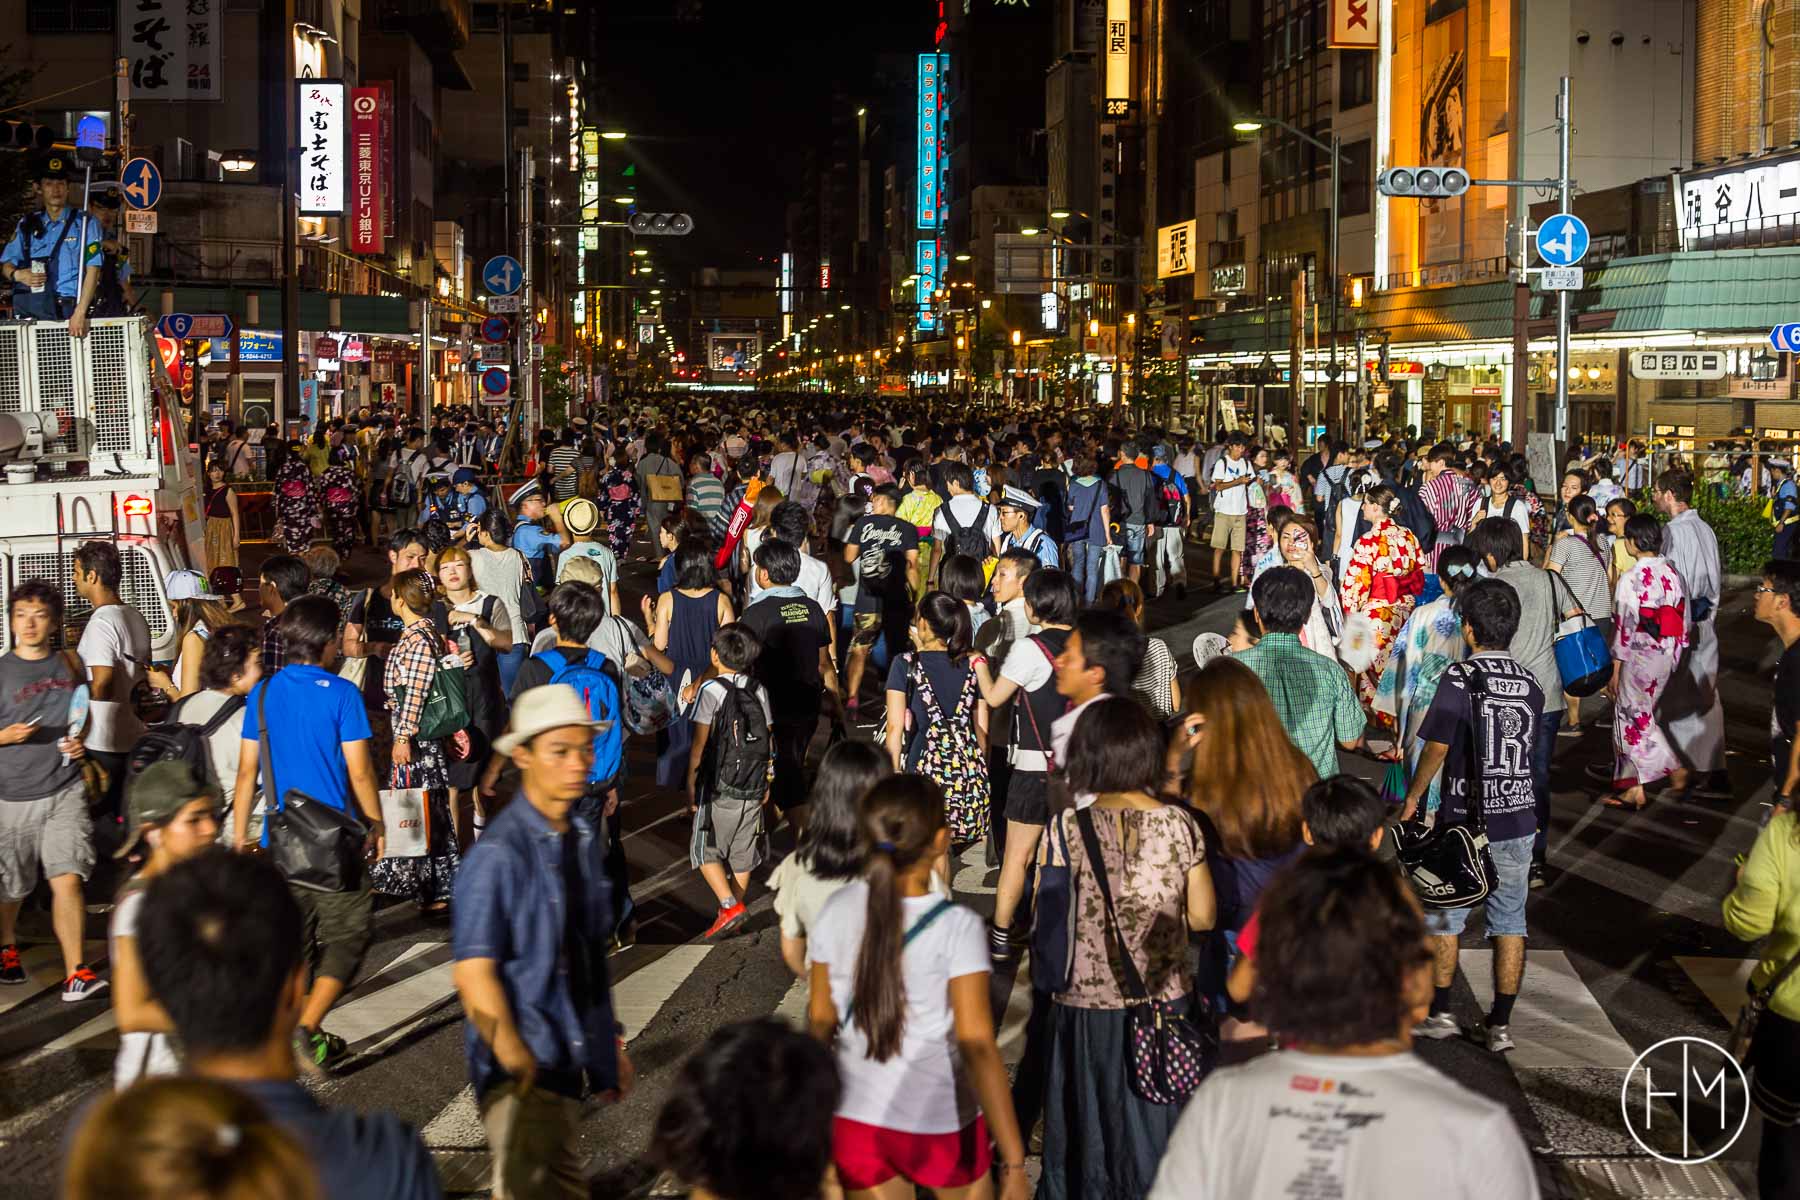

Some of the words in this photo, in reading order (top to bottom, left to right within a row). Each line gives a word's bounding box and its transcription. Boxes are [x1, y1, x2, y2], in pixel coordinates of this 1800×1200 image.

[1111, 23, 1125, 51] 和民
[187, 64, 210, 77] 24
[309, 111, 332, 191] 富士そば
[358, 133, 372, 244] 三菱東京UFJ銀行
[1686, 174, 1797, 228] 神谷バー
[175, 318, 186, 331] 6
[1791, 331, 1800, 344] 6
[1642, 355, 1717, 371] 神谷バー
[861, 523, 902, 546] Everyday
[1495, 680, 1521, 693] 1977
[1482, 698, 1534, 777] R
